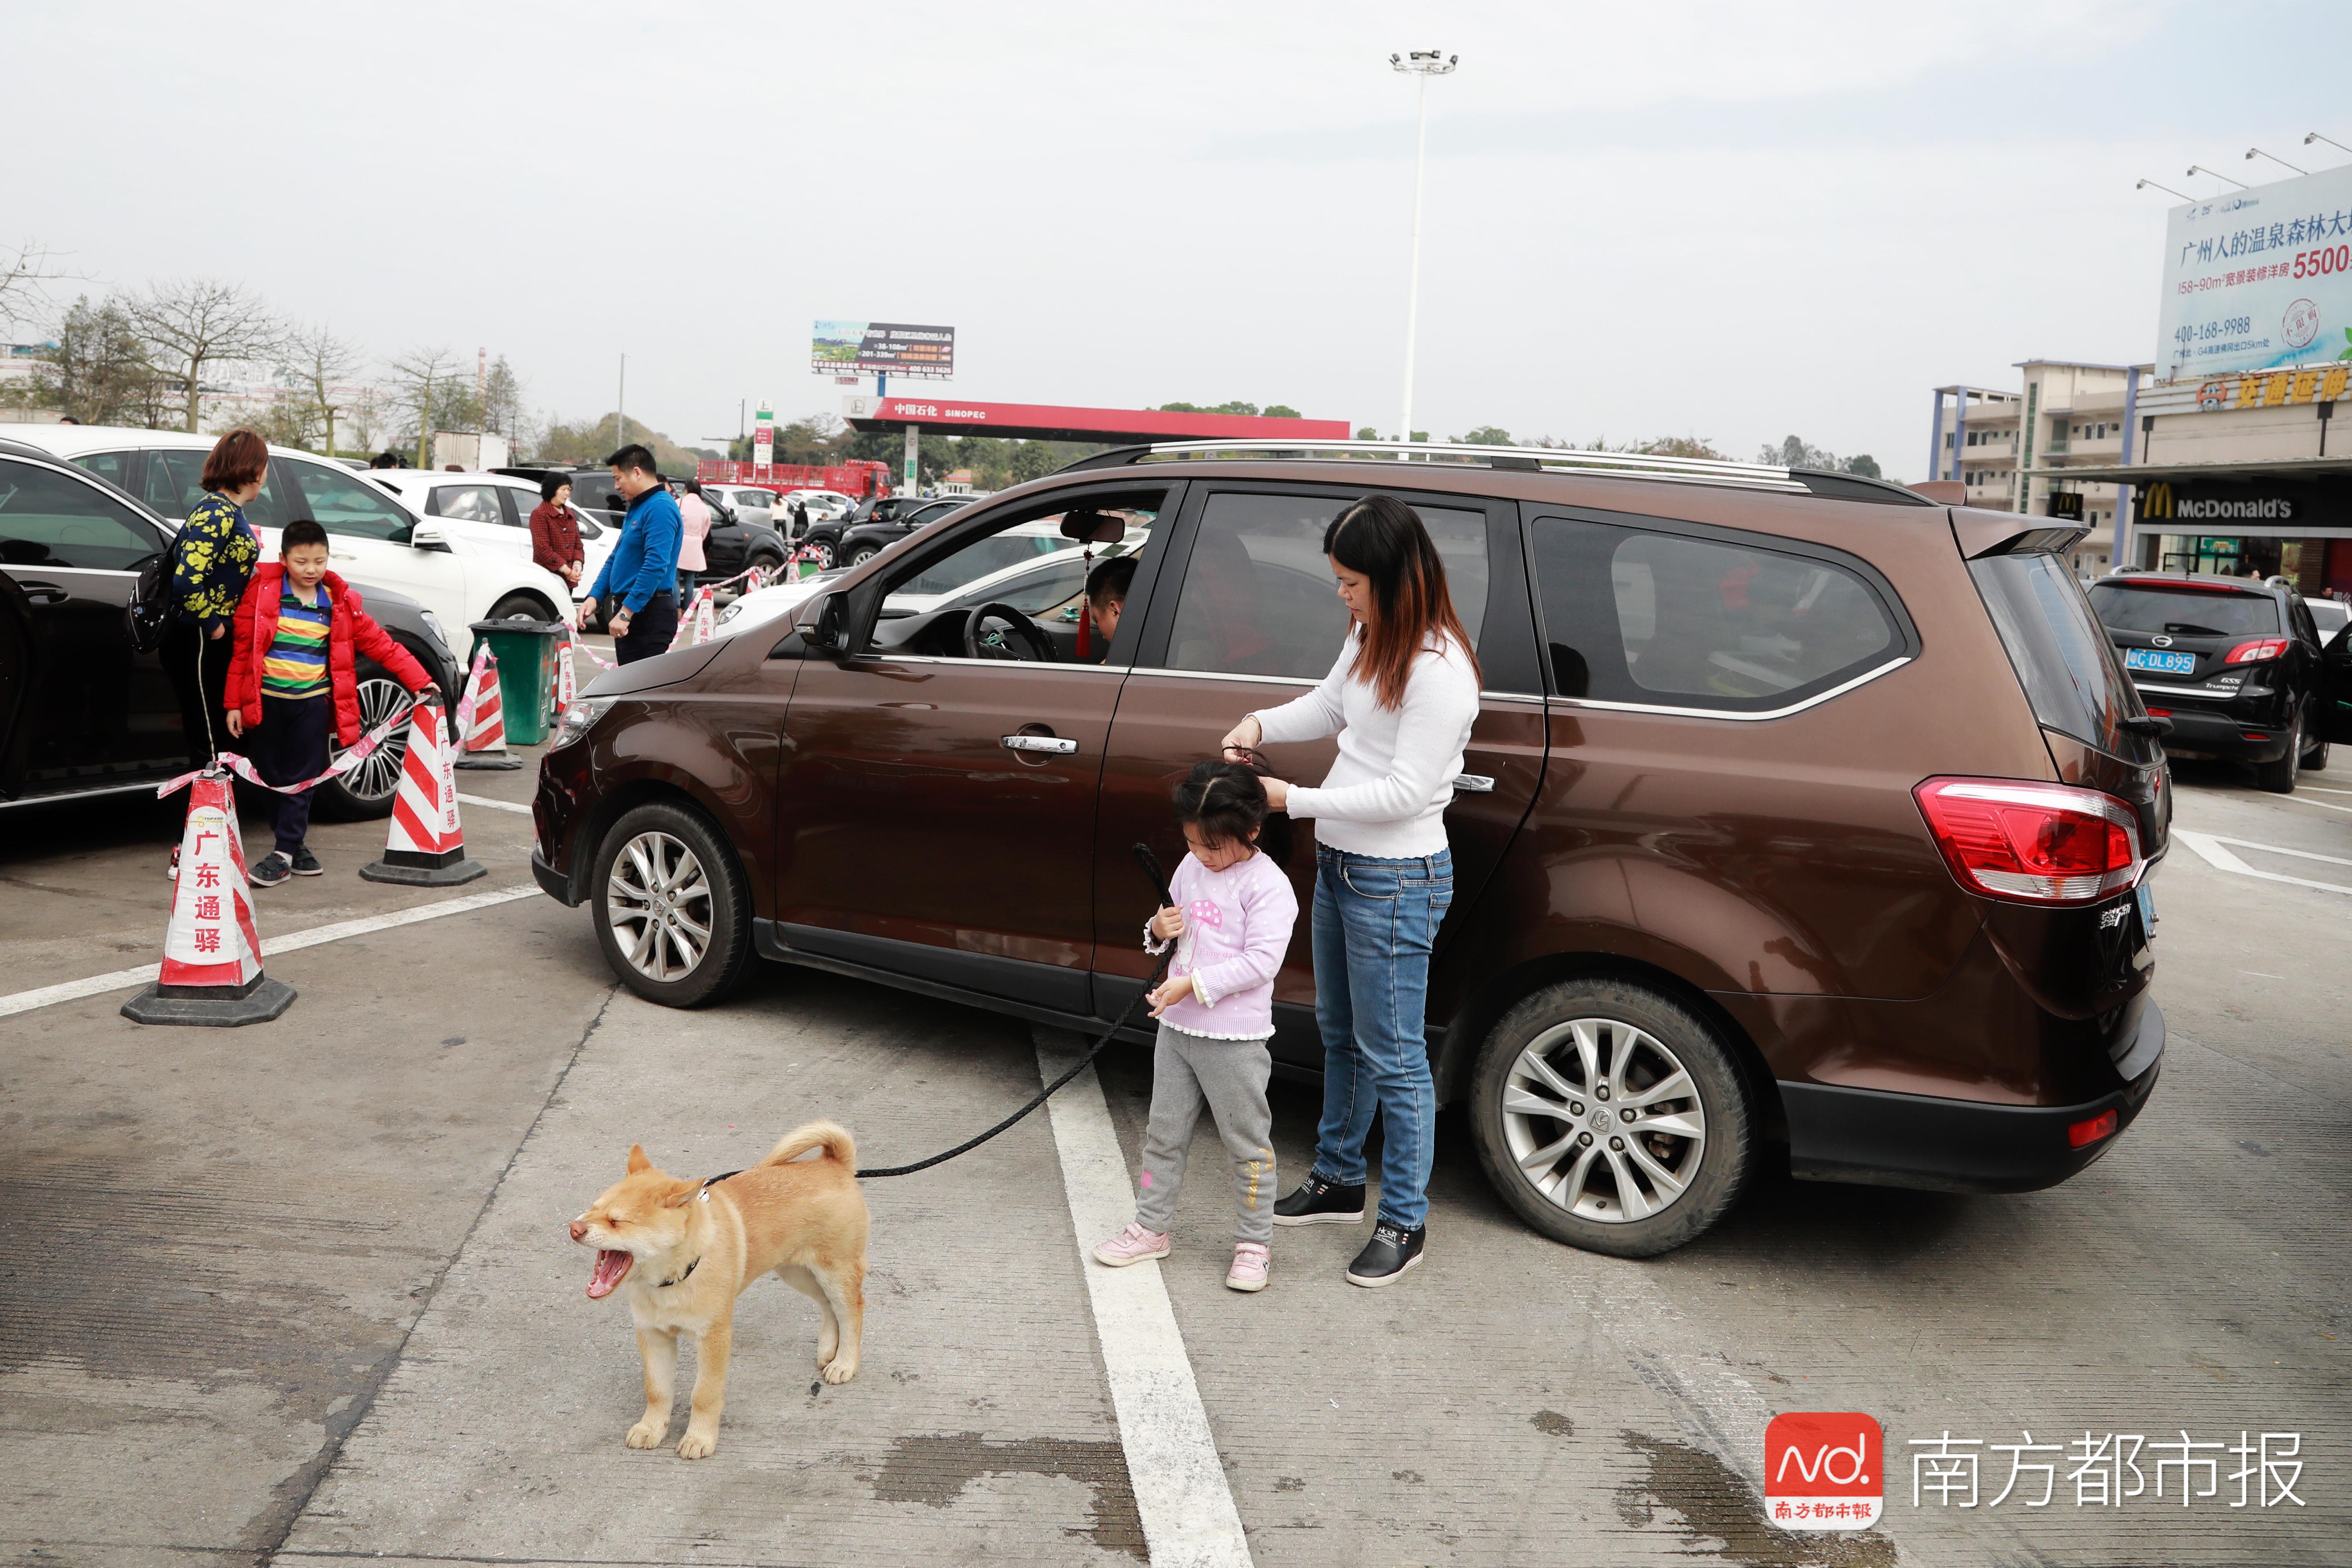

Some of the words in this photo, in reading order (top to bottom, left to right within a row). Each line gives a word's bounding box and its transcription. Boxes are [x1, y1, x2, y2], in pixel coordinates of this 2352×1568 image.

[2175, 316, 2250, 342] 400-168-9988
[2235, 368, 2352, 409] 交通延伸
[894, 403, 938, 417] 中国石化
[945, 409, 986, 419] SINOPEC
[2178, 498, 2292, 519] McDonald's
[441, 737, 456, 828] 广东通驿
[194, 830, 220, 953] 广东通驿
[1200, 948, 1220, 958] Rainy
